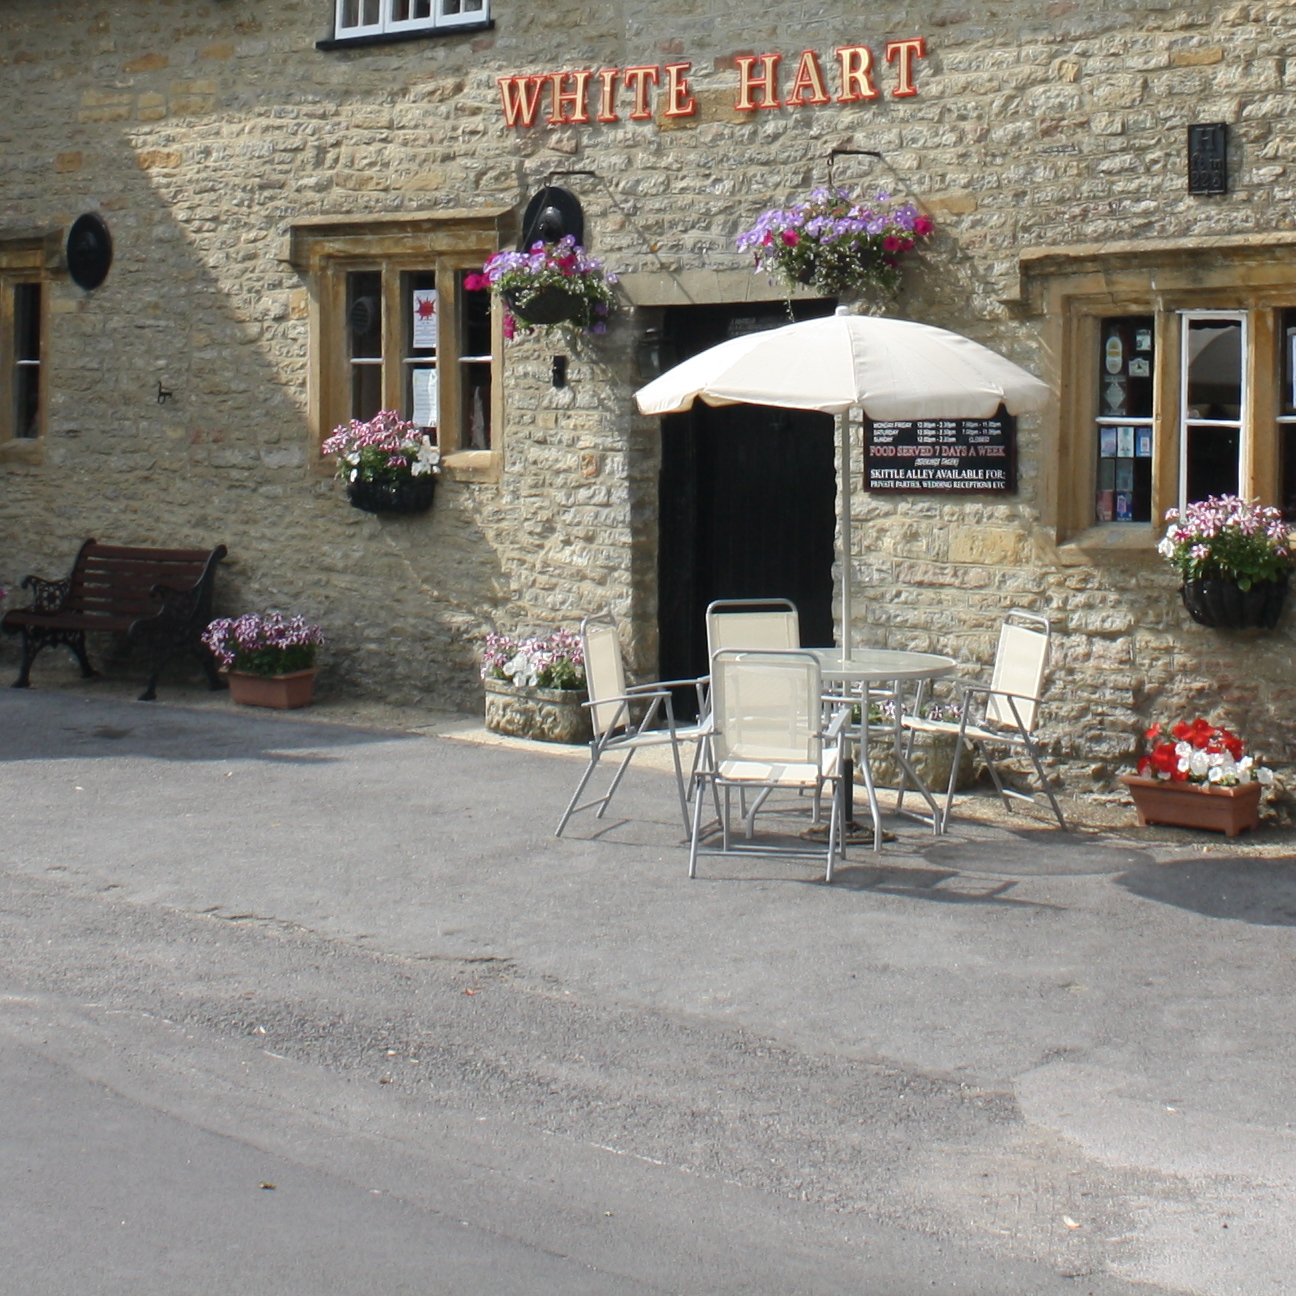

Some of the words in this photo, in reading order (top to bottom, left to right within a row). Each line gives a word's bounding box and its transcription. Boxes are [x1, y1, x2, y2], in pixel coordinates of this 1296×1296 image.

[497, 61, 696, 127] WHITE
[735, 37, 925, 112] HART
[869, 445, 896, 457] FOOD
[896, 445, 934, 457] SERVED
[934, 445, 941, 457] 7
[941, 445, 968, 457] DAYS
[968, 445, 977, 457] A
[977, 445, 1006, 457] WEEK
[870, 468, 905, 479] SKITTLE
[906, 468, 934, 479] ALLEY
[935, 468, 984, 480] AVAILABLE
